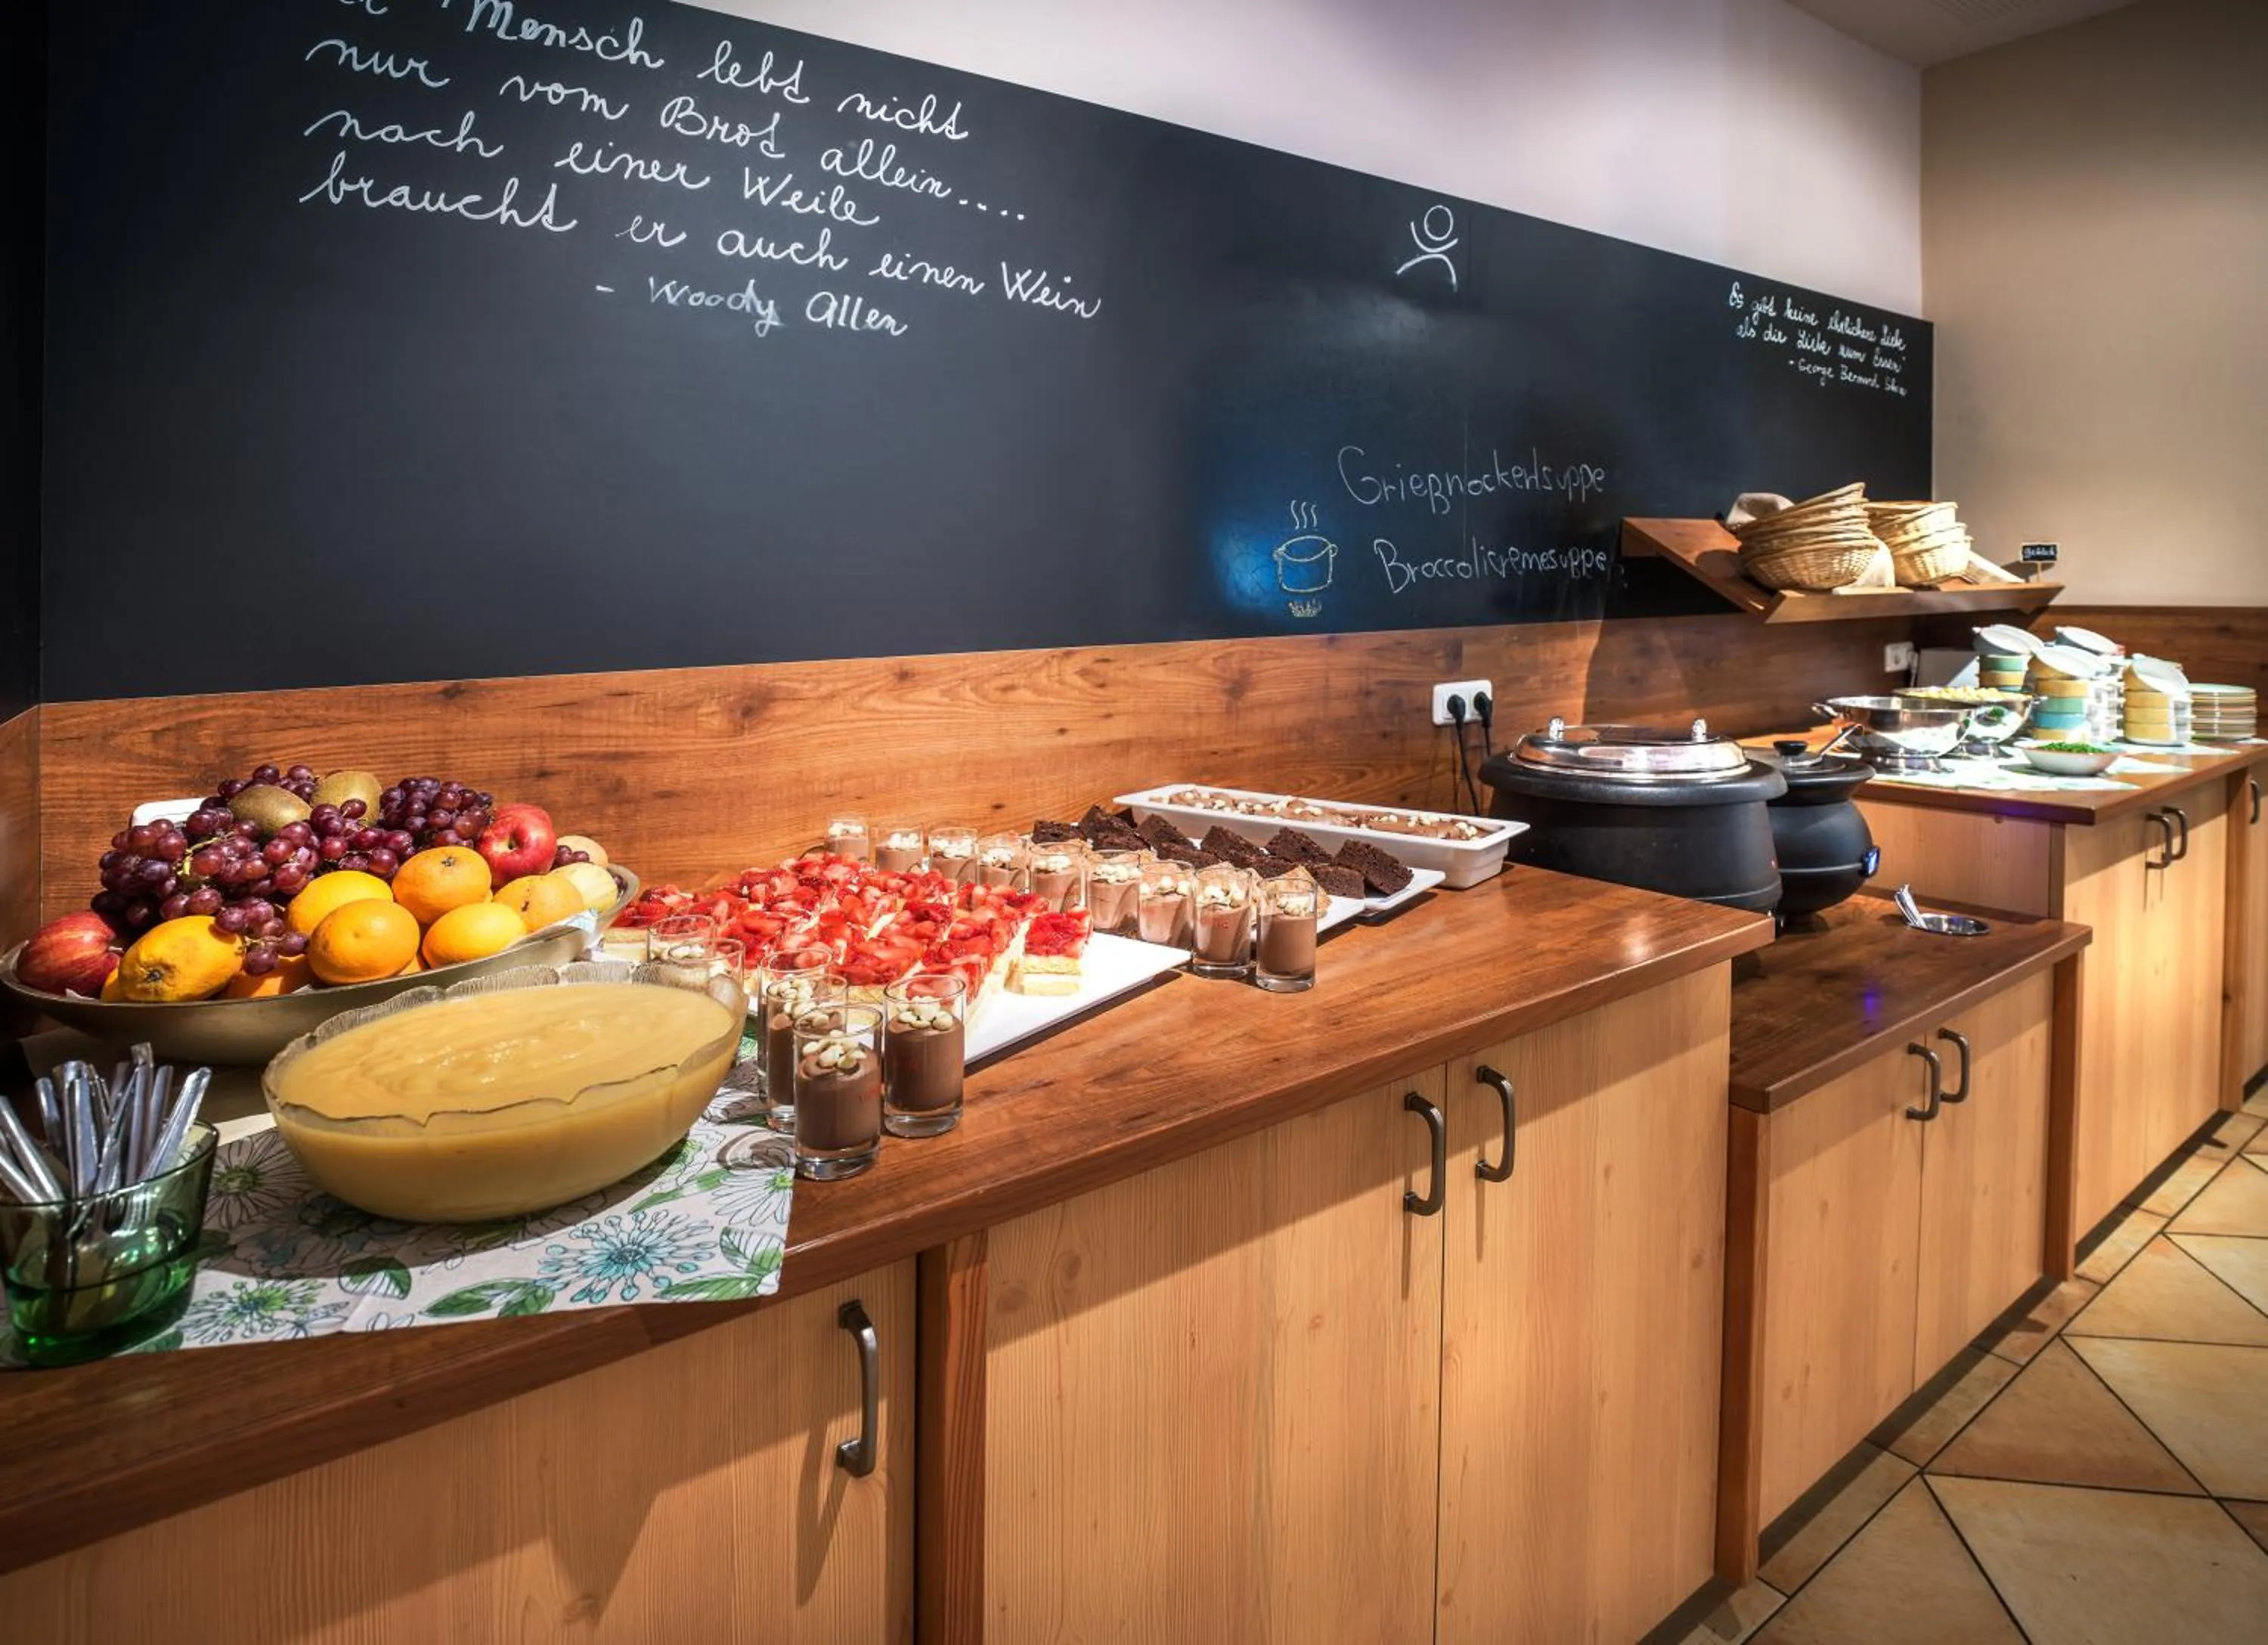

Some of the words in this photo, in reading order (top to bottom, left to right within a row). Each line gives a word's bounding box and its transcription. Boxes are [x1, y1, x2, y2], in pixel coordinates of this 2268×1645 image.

[305, 39, 450, 87] nur
[500, 76, 629, 119] vom
[661, 97, 785, 157] Brot
[442, 0, 664, 68] Mensch
[697, 40, 810, 104] lebt
[837, 94, 968, 139] nicht
[304, 110, 503, 157] nach
[554, 142, 710, 188] einer
[743, 167, 879, 225] Weile
[299, 151, 578, 231] braucht
[615, 215, 686, 246] er
[717, 228, 848, 270] auch
[869, 253, 984, 295] einen
[1001, 262, 1101, 318] Wein
[649, 277, 782, 337] Woody
[805, 291, 907, 336] Allen
[1762, 323, 1788, 343] die
[1784, 298, 1819, 326] keine
